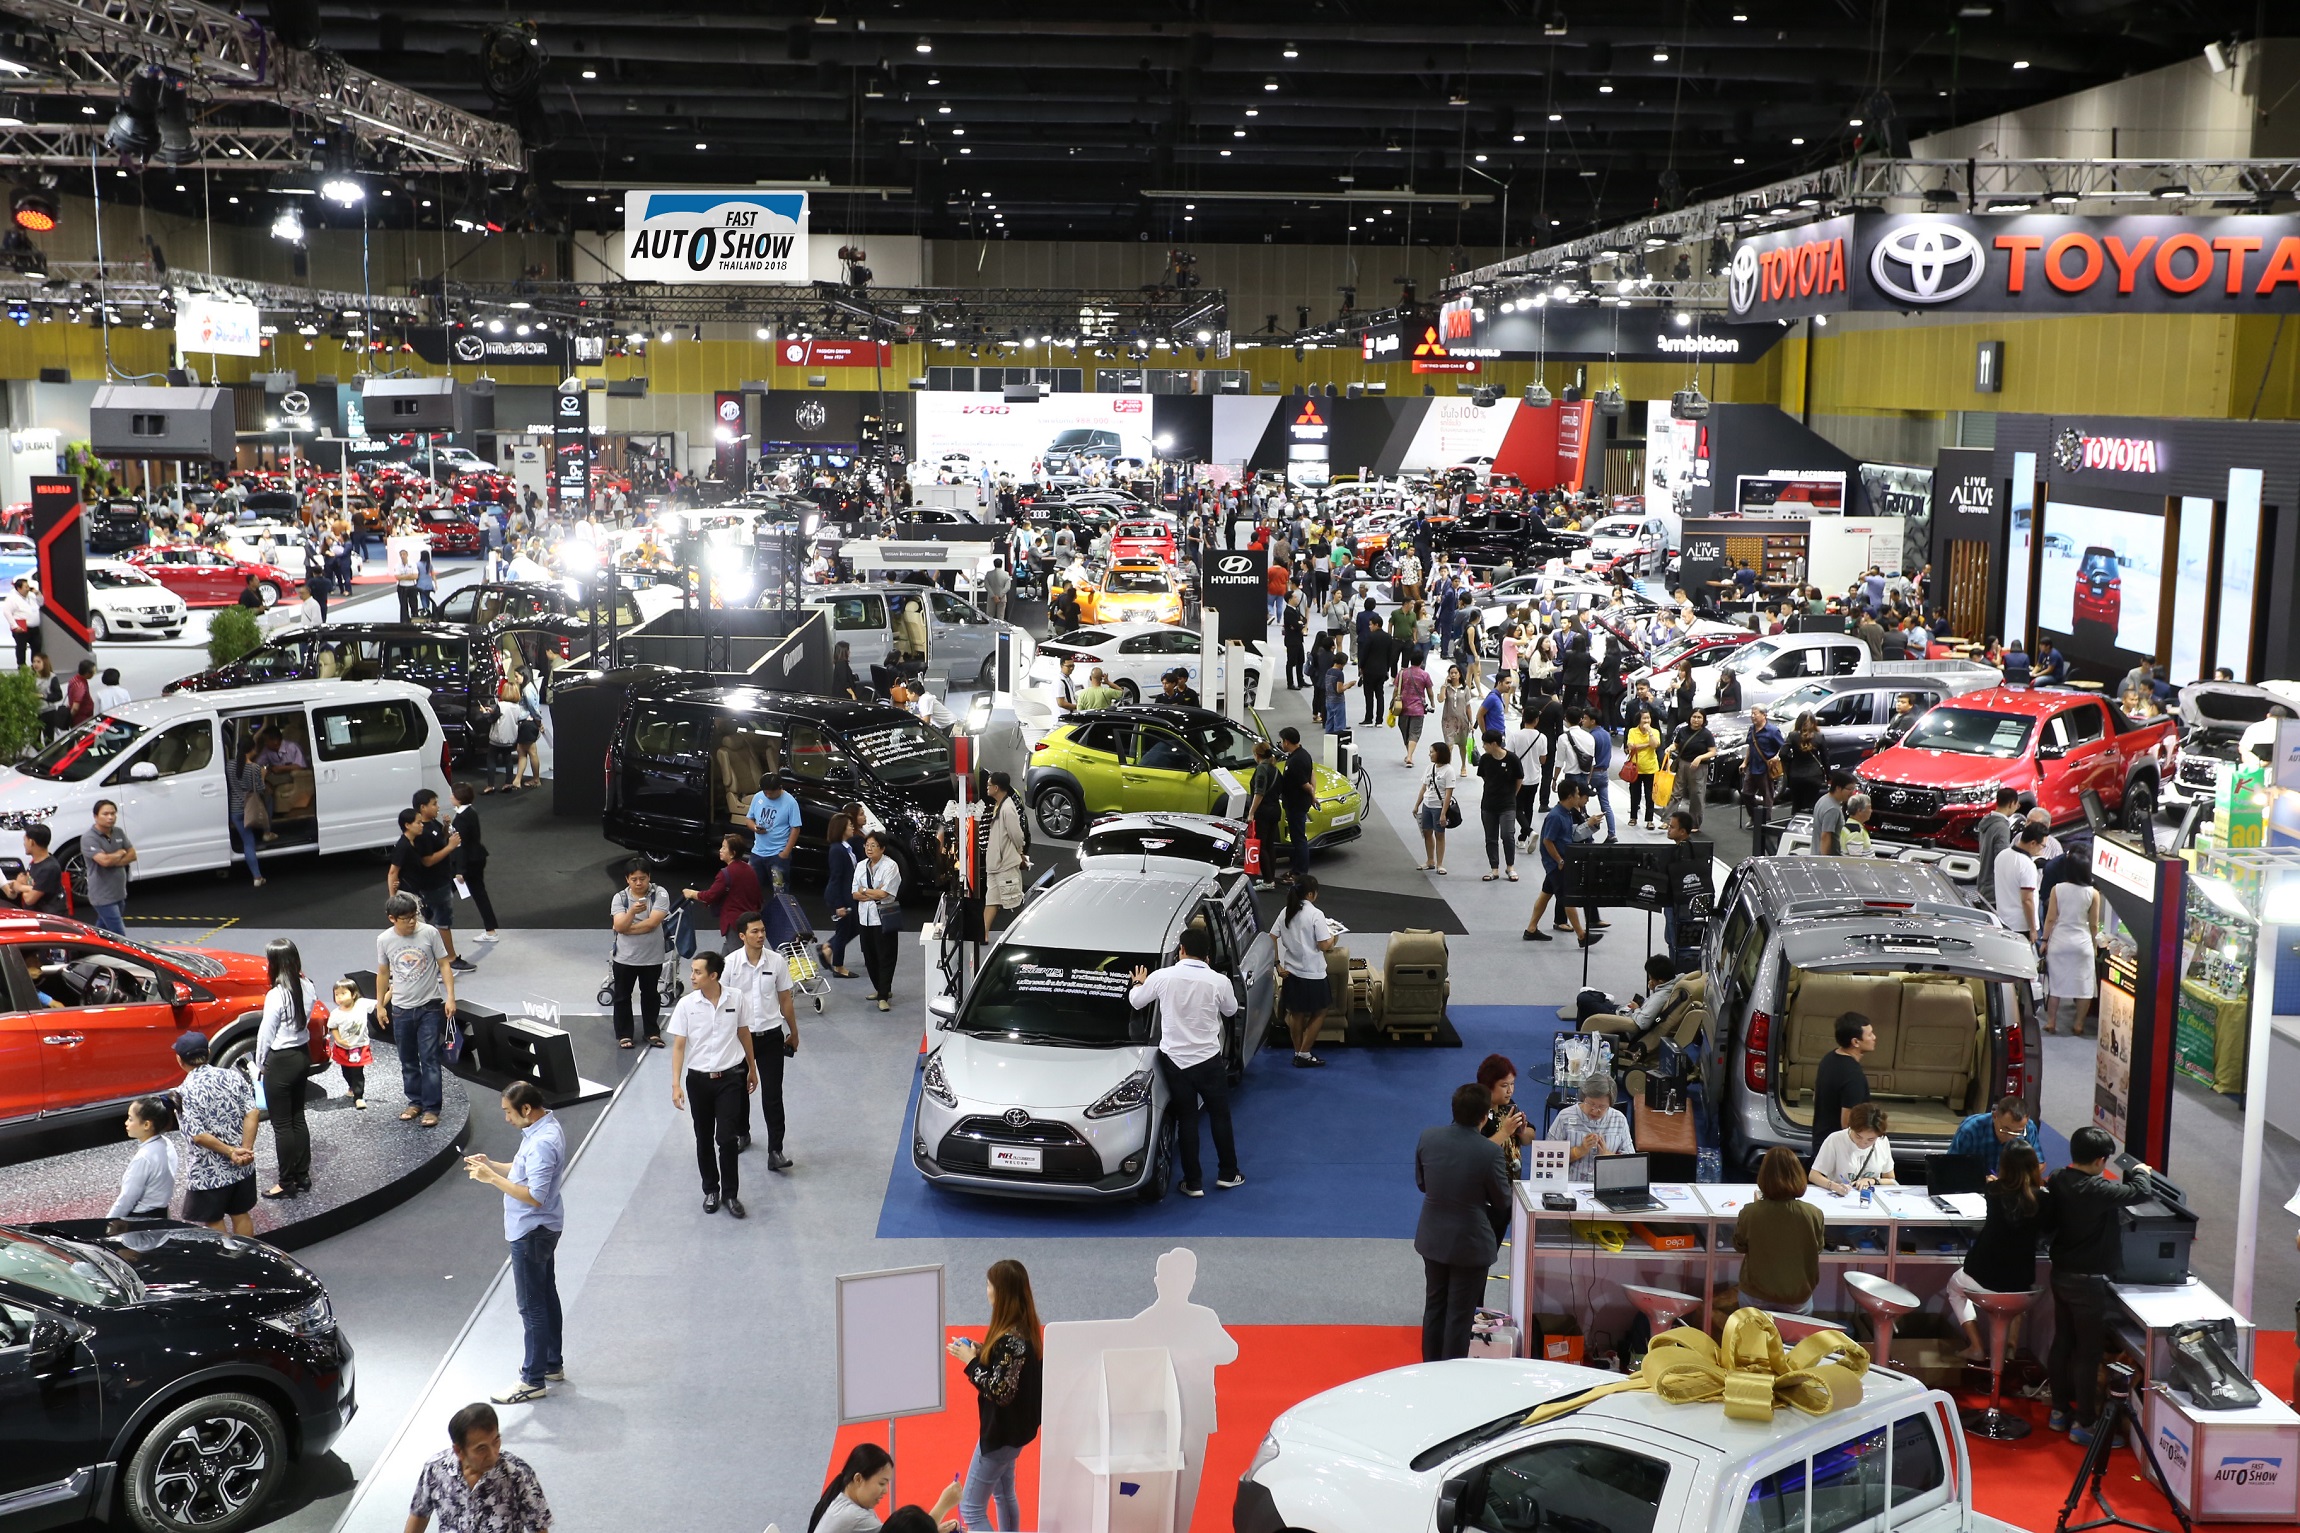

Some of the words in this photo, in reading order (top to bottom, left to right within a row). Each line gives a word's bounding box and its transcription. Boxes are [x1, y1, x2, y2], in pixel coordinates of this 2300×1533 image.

[1760, 236, 1846, 302] TOYOTA
[1995, 232, 2300, 294] TOYOTA
[1447, 308, 1472, 339] TOYOTA
[1657, 335, 1739, 353] Ambition
[2082, 437, 2156, 473] TOYOTA
[36, 485, 72, 494] ISUZU
[1964, 476, 1986, 487] LIVE
[1211, 575, 1259, 584] HYUNDAI
[761, 807, 777, 820] MC
[2159, 1437, 2174, 1460] AUTO
[2173, 1449, 2187, 1469] SHOW
[2215, 1469, 2248, 1485] AUTO
[2248, 1470, 2278, 1482] SHOW
